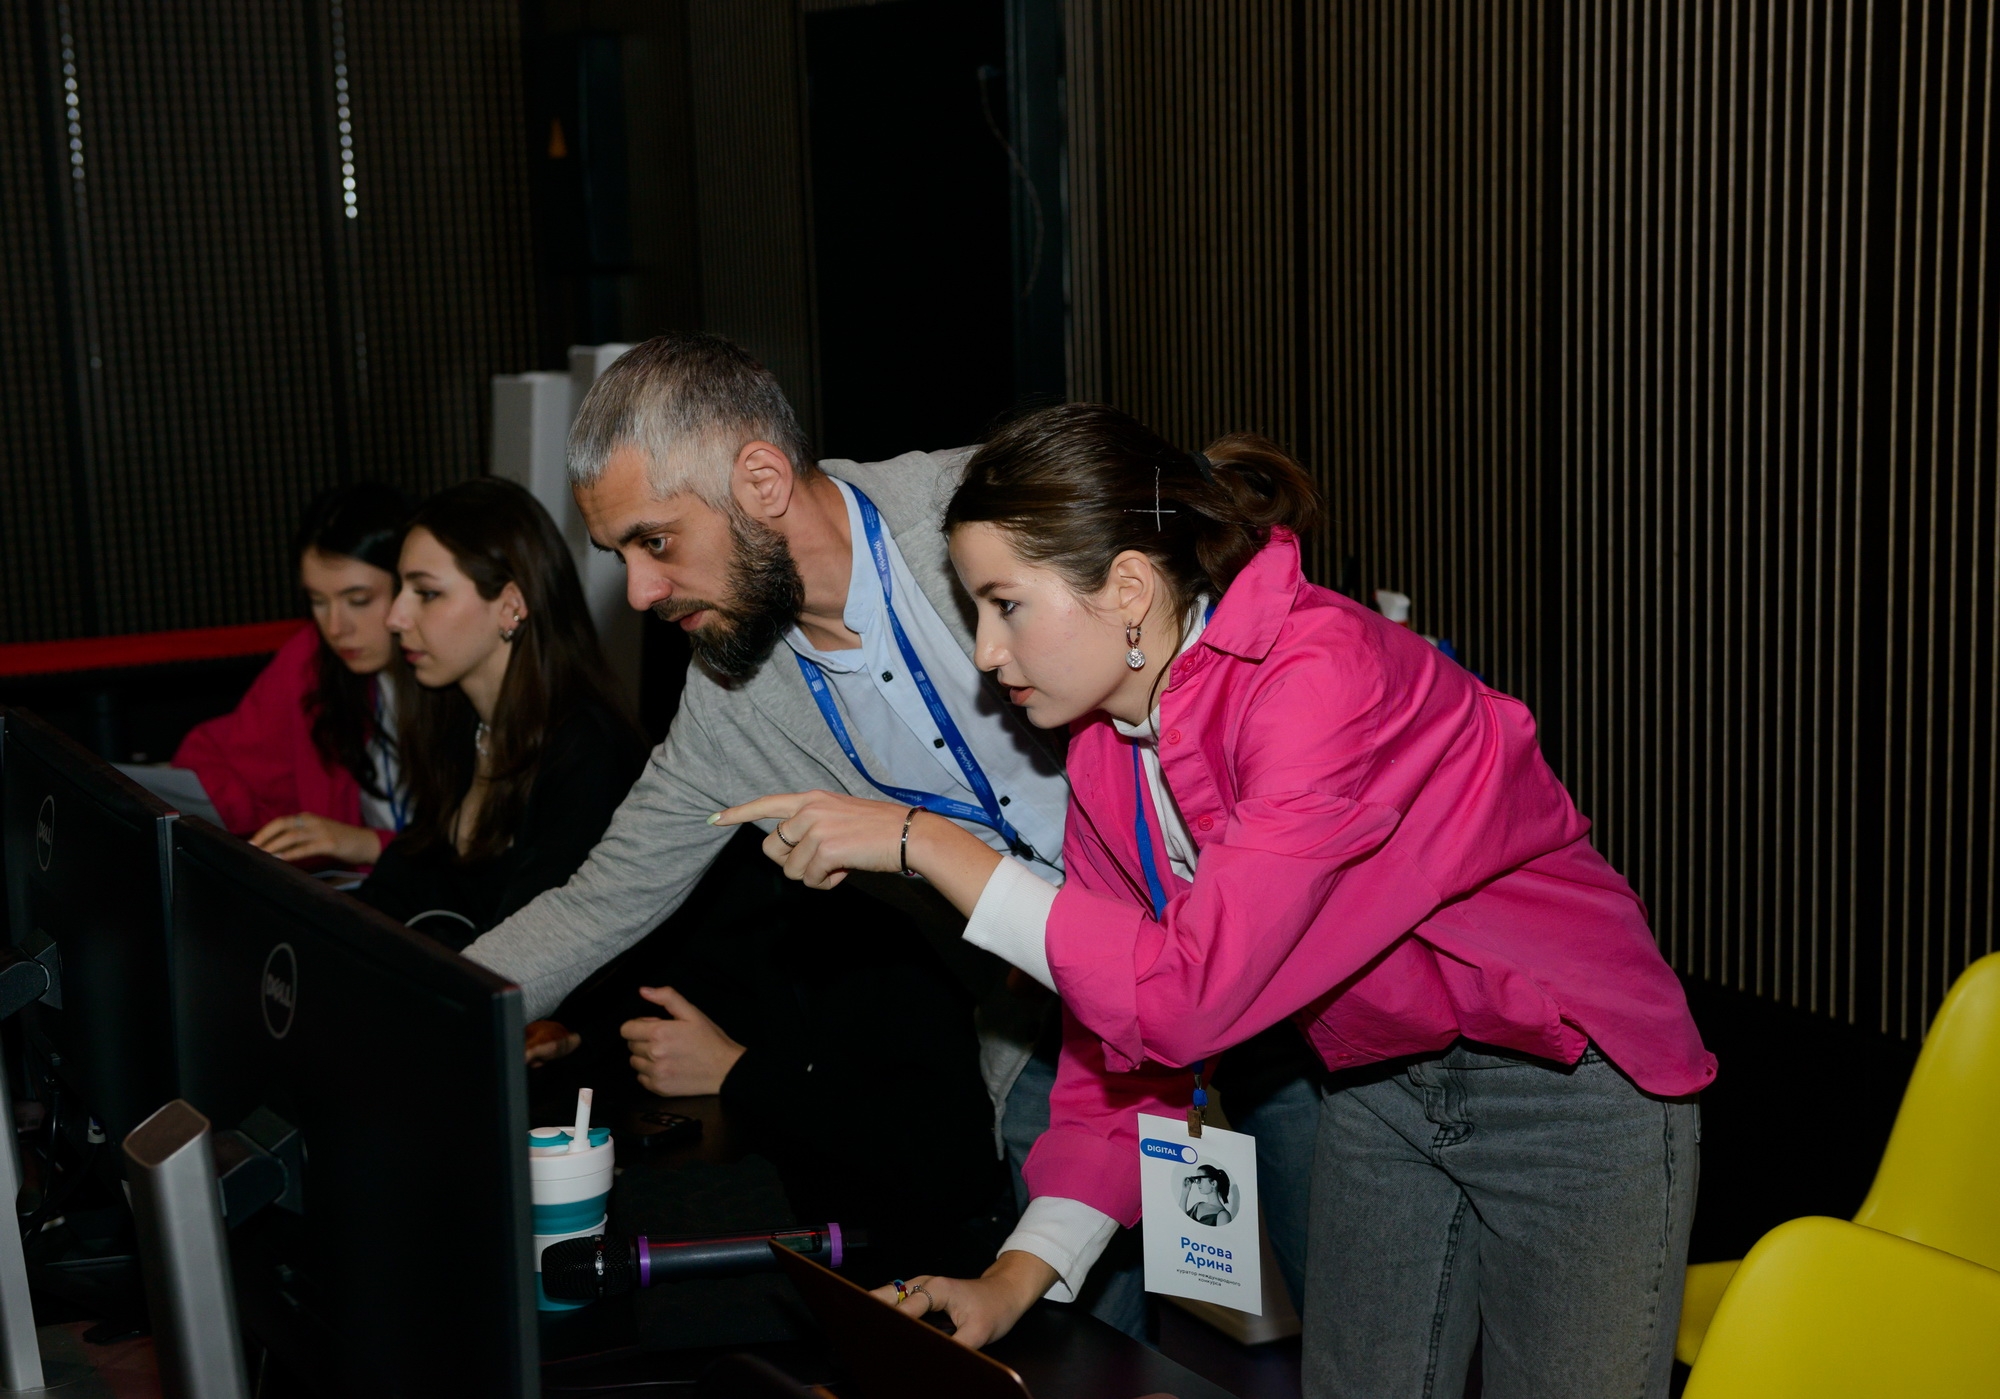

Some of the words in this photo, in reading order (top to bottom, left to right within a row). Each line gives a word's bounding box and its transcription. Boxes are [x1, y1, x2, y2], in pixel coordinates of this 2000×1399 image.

[266, 973, 292, 1008] DELL
[1147, 1144, 1177, 1156] DIGITAL
[1180, 1236, 1233, 1260] Рогова
[1184, 1251, 1233, 1274] Арина
[1176, 1268, 1198, 1276] куратор
[1198, 1272, 1241, 1287] международного
[1198, 1278, 1222, 1287] конкурса
